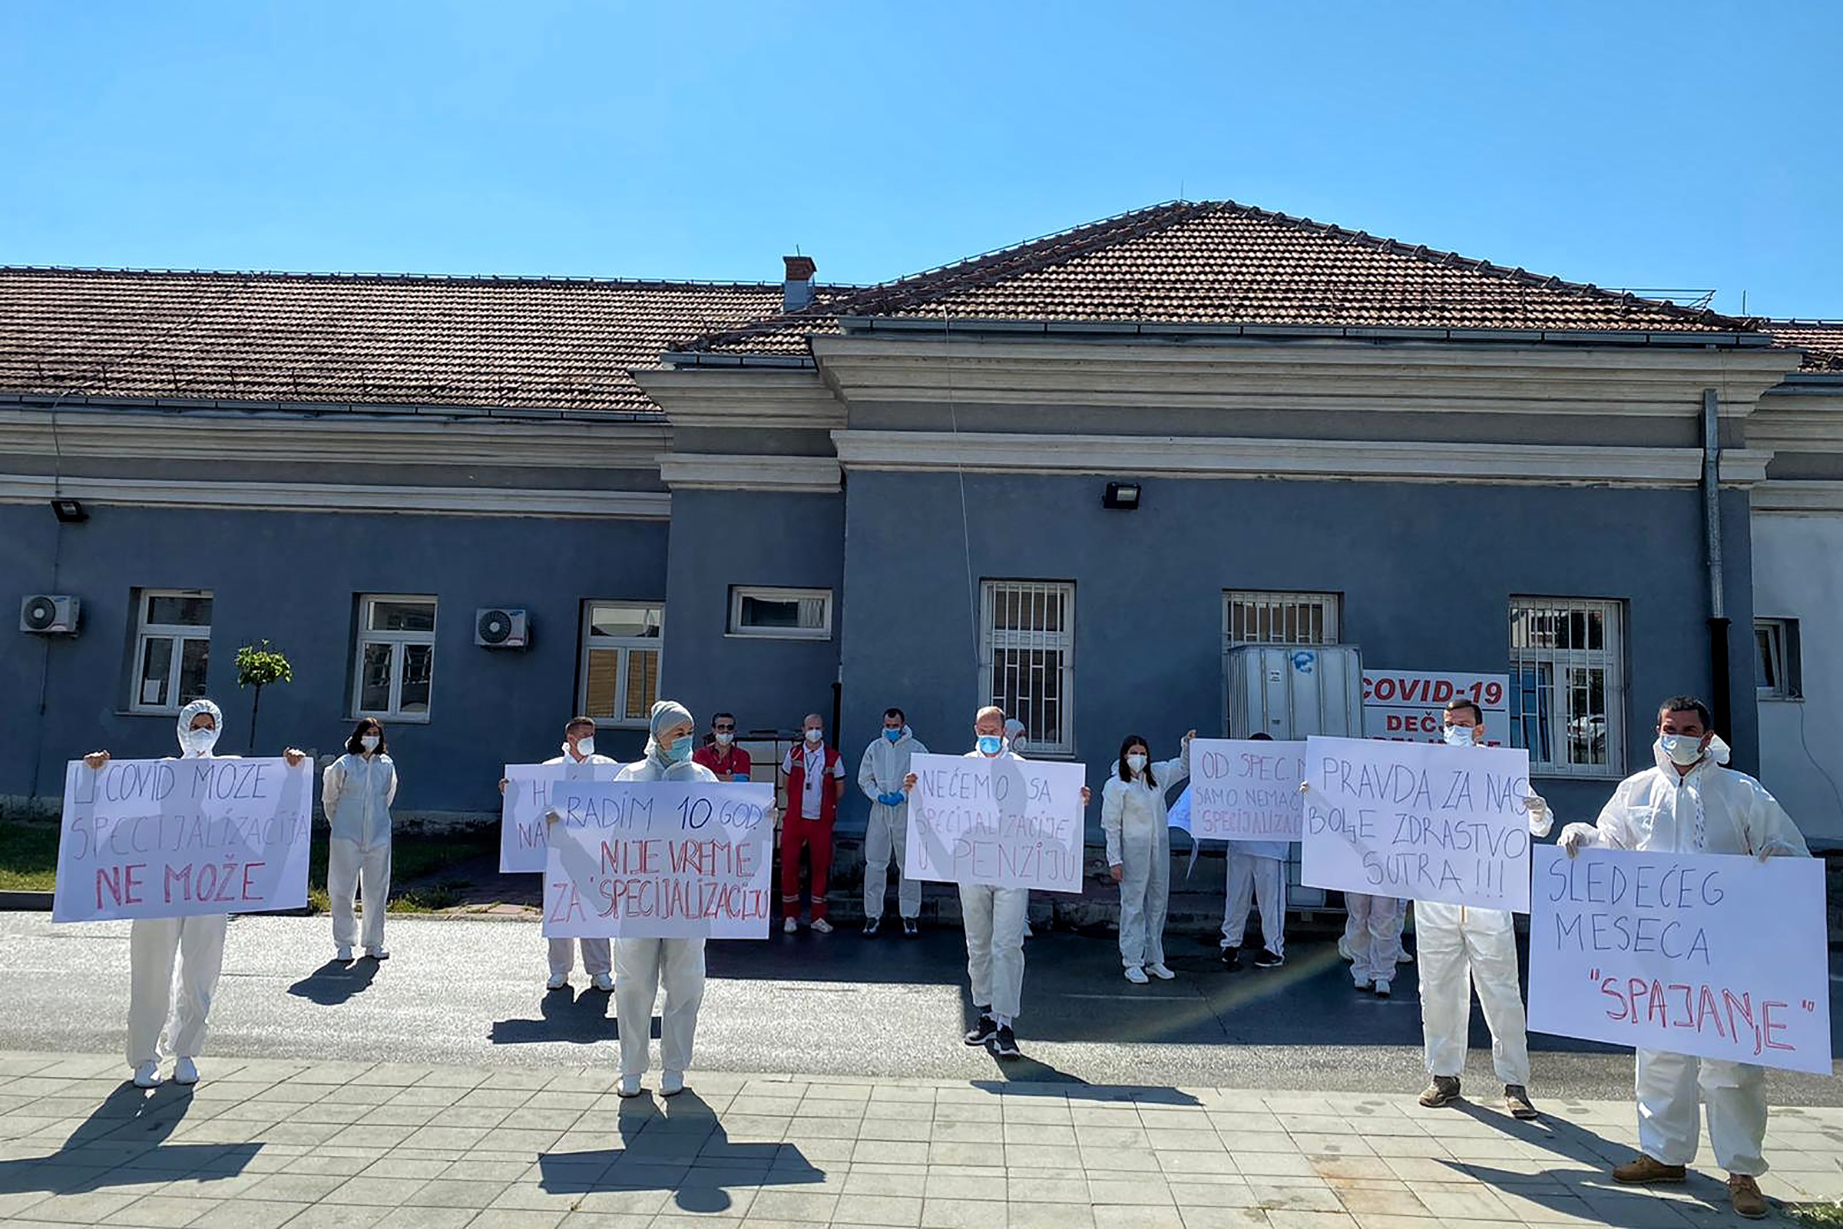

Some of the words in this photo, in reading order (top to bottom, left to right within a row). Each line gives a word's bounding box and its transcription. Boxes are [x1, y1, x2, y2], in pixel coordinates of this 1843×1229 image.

[1364, 677, 1503, 704] COVID-19
[106, 761, 175, 802] COVID
[1202, 751, 1229, 779] OD
[1239, 753, 1290, 780] SPEC.
[1323, 758, 1432, 811] PRAVDA
[1442, 771, 1473, 811] ZA
[1486, 773, 1528, 815] NAS
[566, 791, 654, 830] RADIM
[679, 796, 712, 829] 10
[1027, 777, 1052, 803] SA
[1196, 786, 1238, 807] SAMO
[1392, 813, 1527, 859] ZDRASTVO
[601, 840, 662, 874] NIJE
[669, 839, 755, 878] VREME
[919, 841, 928, 870] U
[953, 838, 1076, 882] PENZIJU
[96, 864, 147, 909] NE
[165, 854, 266, 903] MOŽE
[550, 881, 586, 924] ZA
[1549, 858, 1724, 908] SLEDEĆEG
[1556, 913, 1710, 965] MESECA
